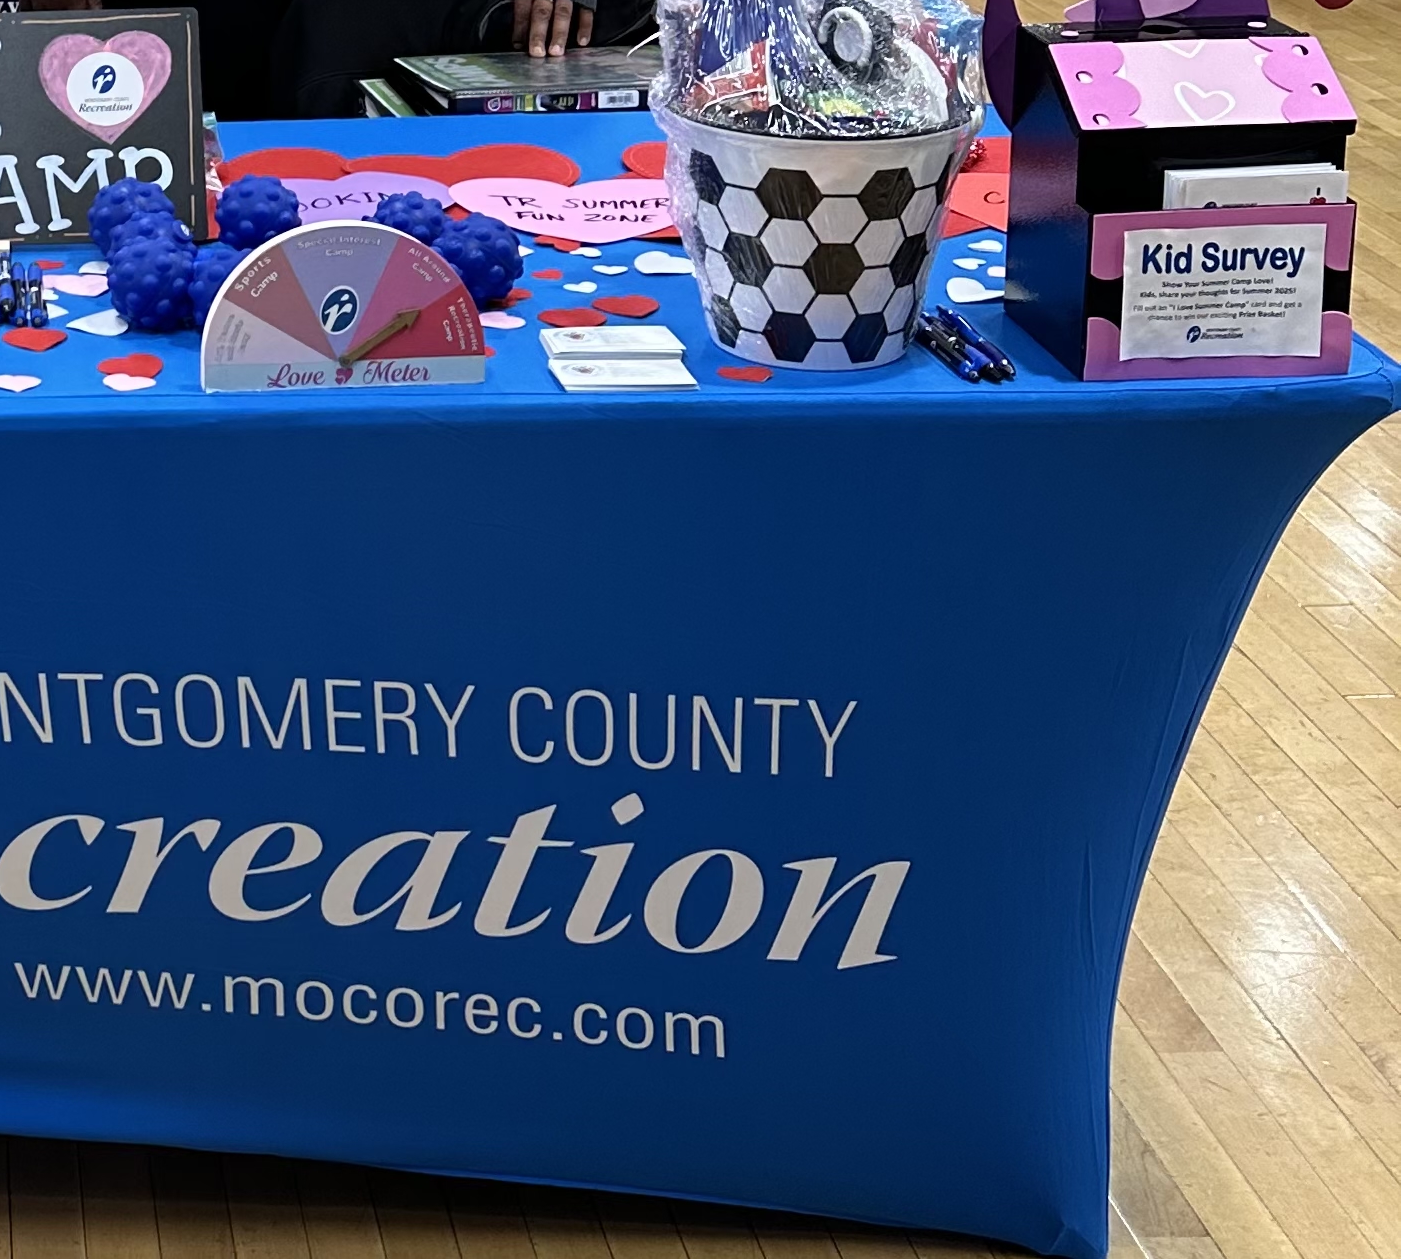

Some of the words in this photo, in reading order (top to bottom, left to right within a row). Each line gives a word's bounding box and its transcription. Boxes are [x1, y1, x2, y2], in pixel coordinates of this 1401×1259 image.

[78, 102, 133, 113] Recreation
[488, 194, 546, 209] TR
[562, 197, 670, 211] SUMMER
[512, 210, 565, 223] FUN
[582, 212, 659, 224] ZONE
[408, 247, 421, 258] All
[1141, 243, 1193, 275] Kid
[1200, 242, 1306, 278] Survey
[234, 255, 273, 293] Sports
[250, 271, 279, 299] Camp
[1231, 278, 1252, 286] Camp
[442, 319, 453, 343] Camp
[267, 364, 326, 389] Love
[363, 361, 432, 384] Meter
[508, 686, 858, 779] COUNTY
[13, 960, 728, 1059] www.mocorec.com
